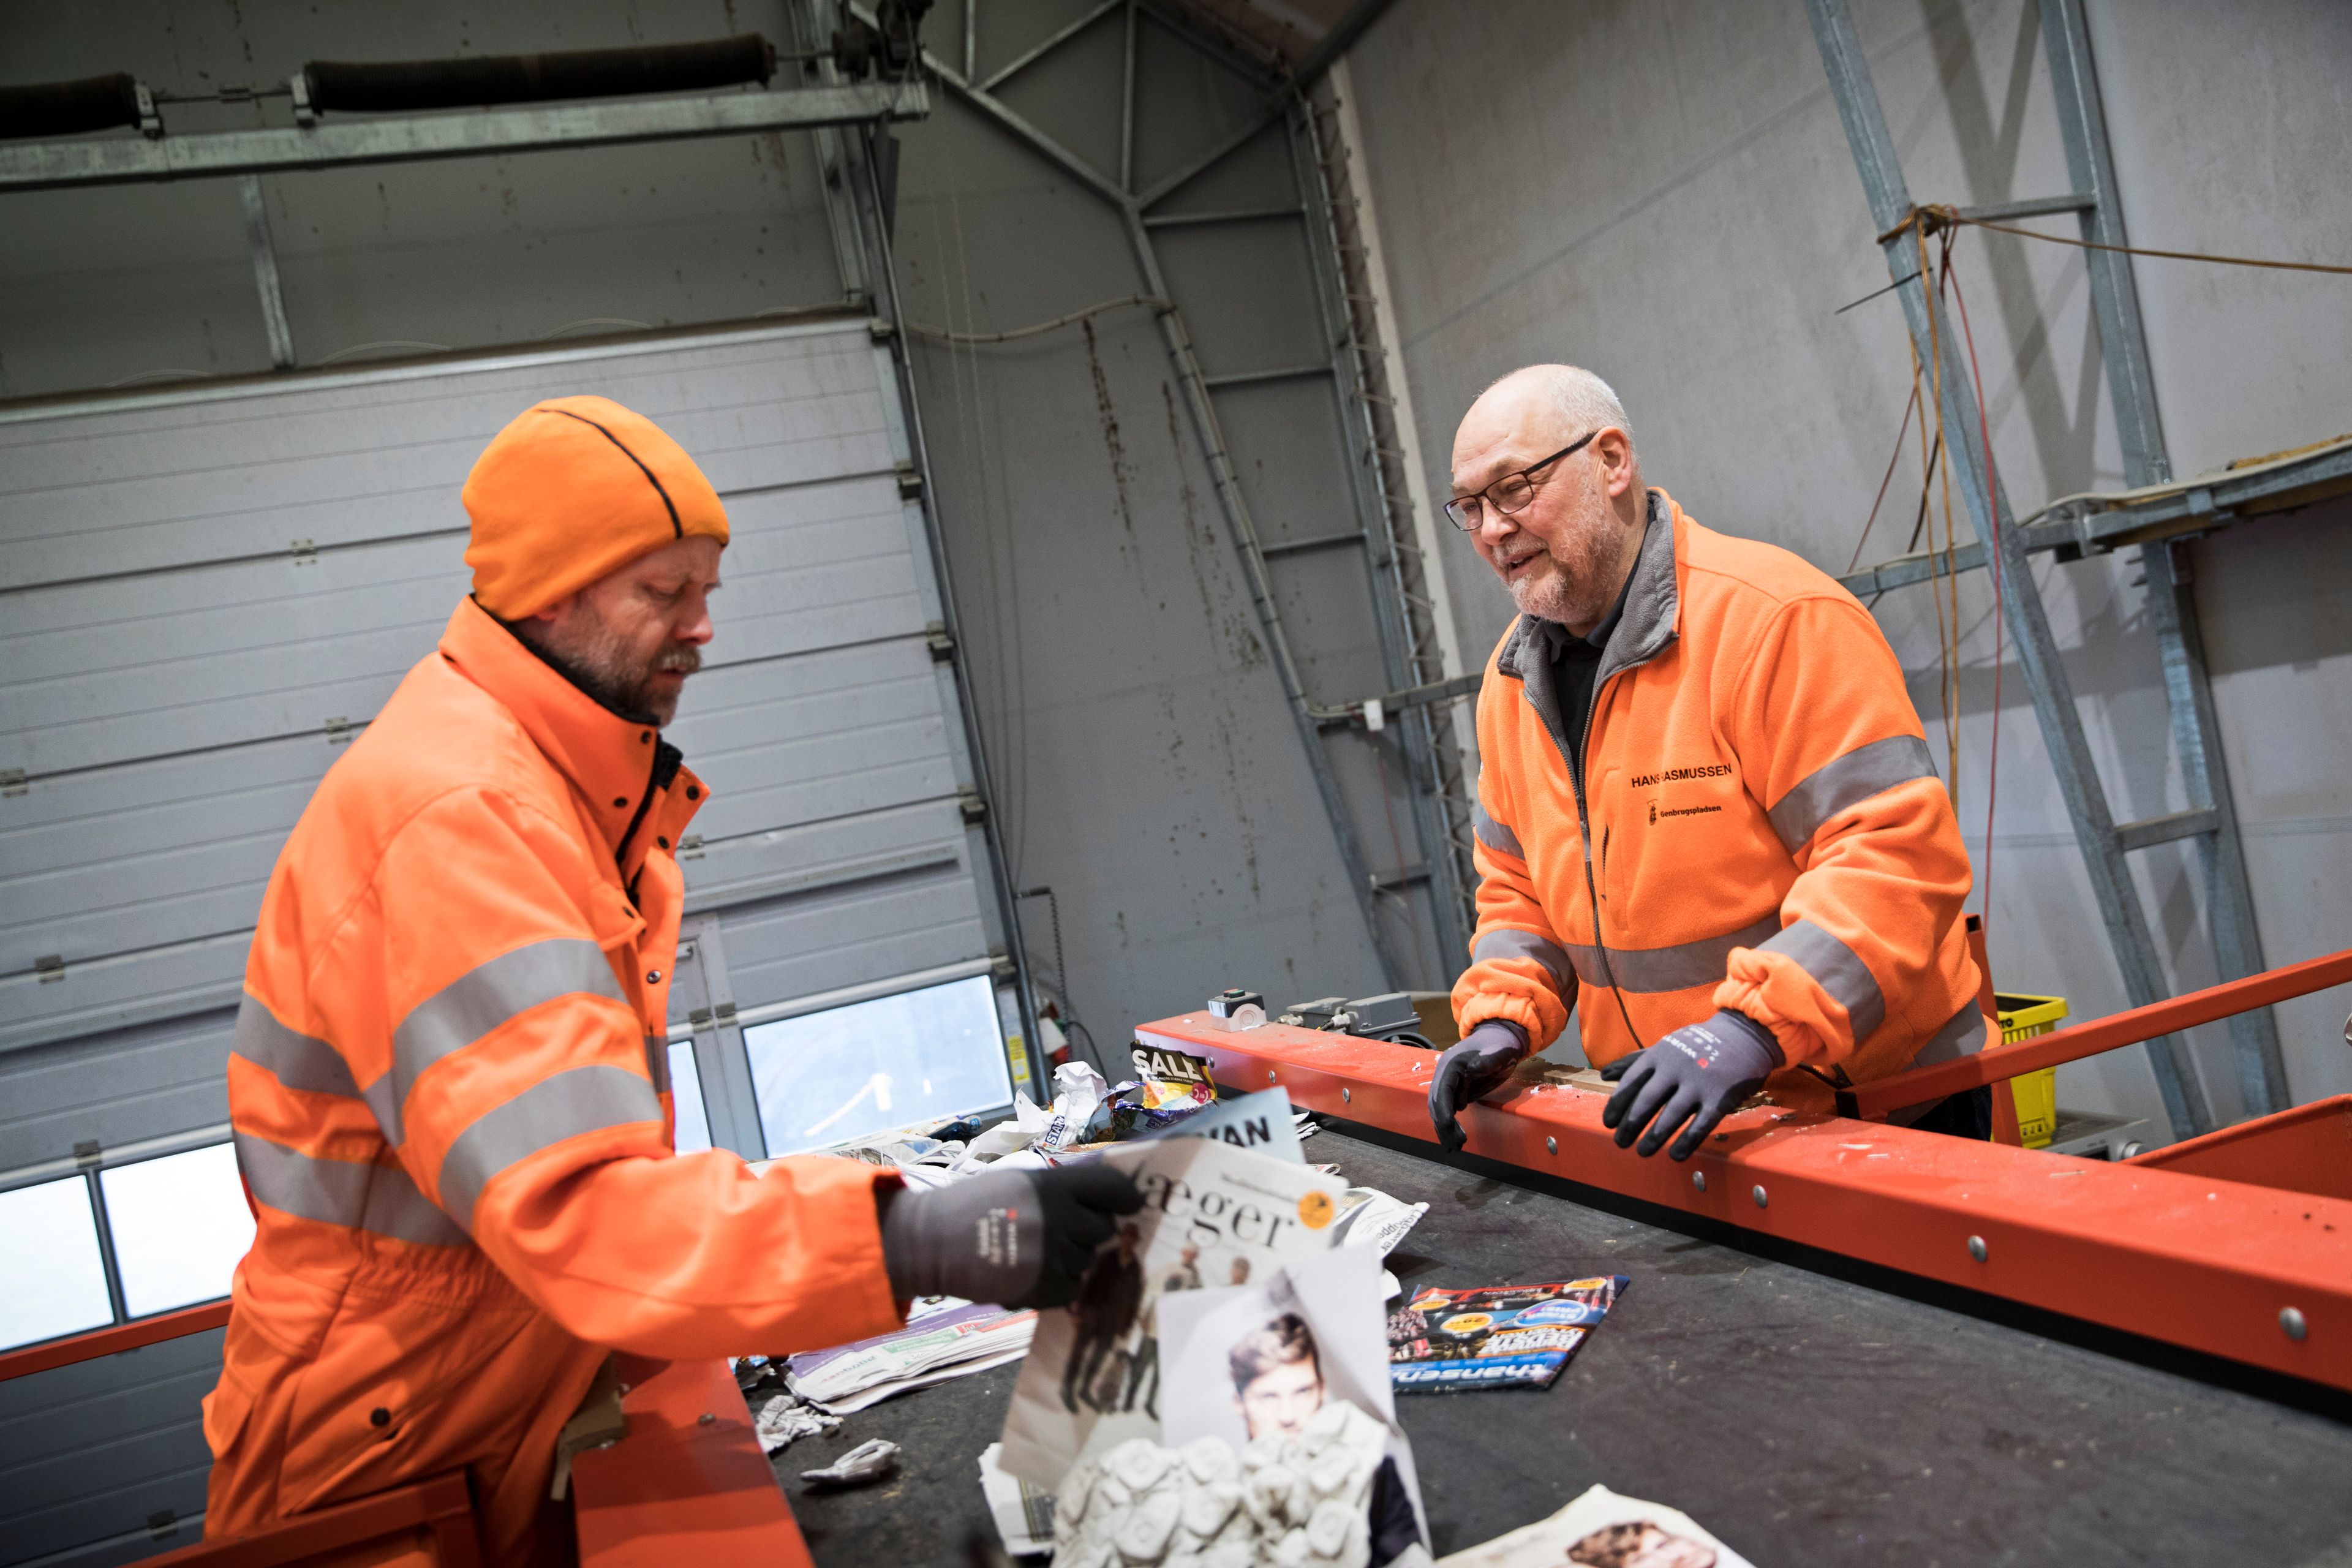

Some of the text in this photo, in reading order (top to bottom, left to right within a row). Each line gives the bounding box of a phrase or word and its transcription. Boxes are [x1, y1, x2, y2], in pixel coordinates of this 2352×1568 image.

[1661, 763, 1732, 782] ASMUSSEN
[1660, 805, 1722, 818] Genbrugspladsen
[1132, 1049, 1204, 1080] SALE
